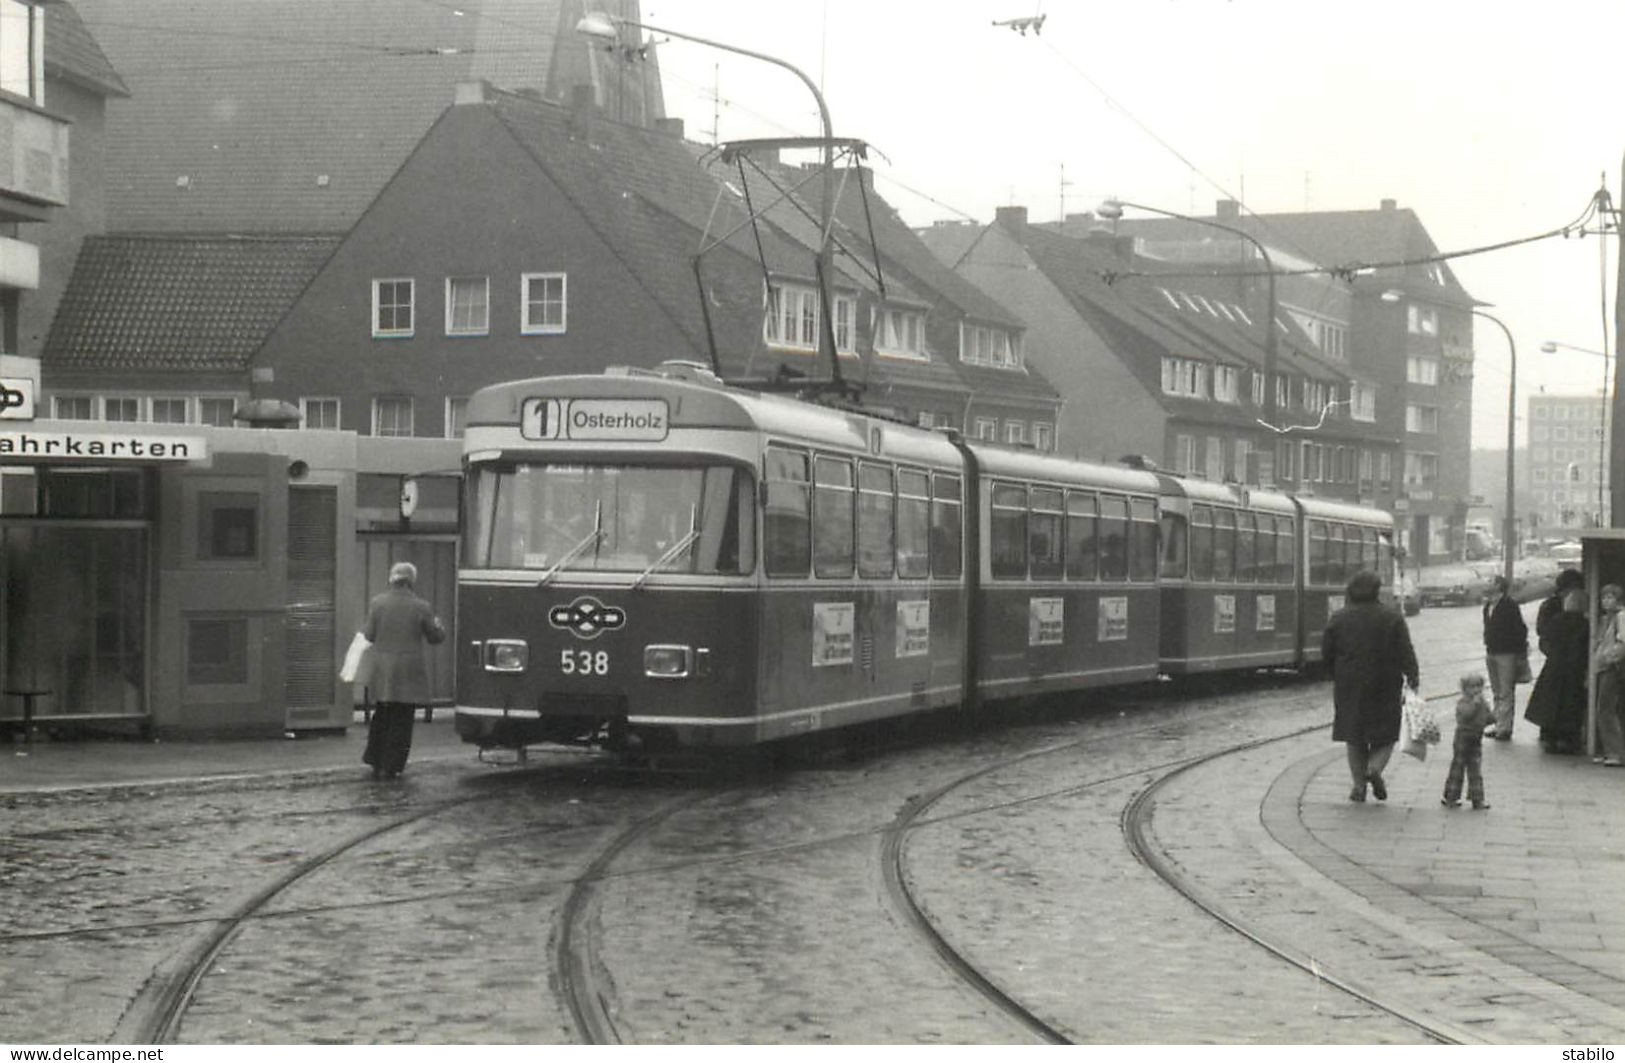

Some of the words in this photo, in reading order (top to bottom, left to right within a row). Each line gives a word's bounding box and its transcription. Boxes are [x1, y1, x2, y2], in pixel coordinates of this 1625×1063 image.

[534, 401, 549, 437] 1
[573, 411, 662, 428] Osterholz
[0, 435, 188, 457] ahrkarten
[561, 650, 608, 675] 538
